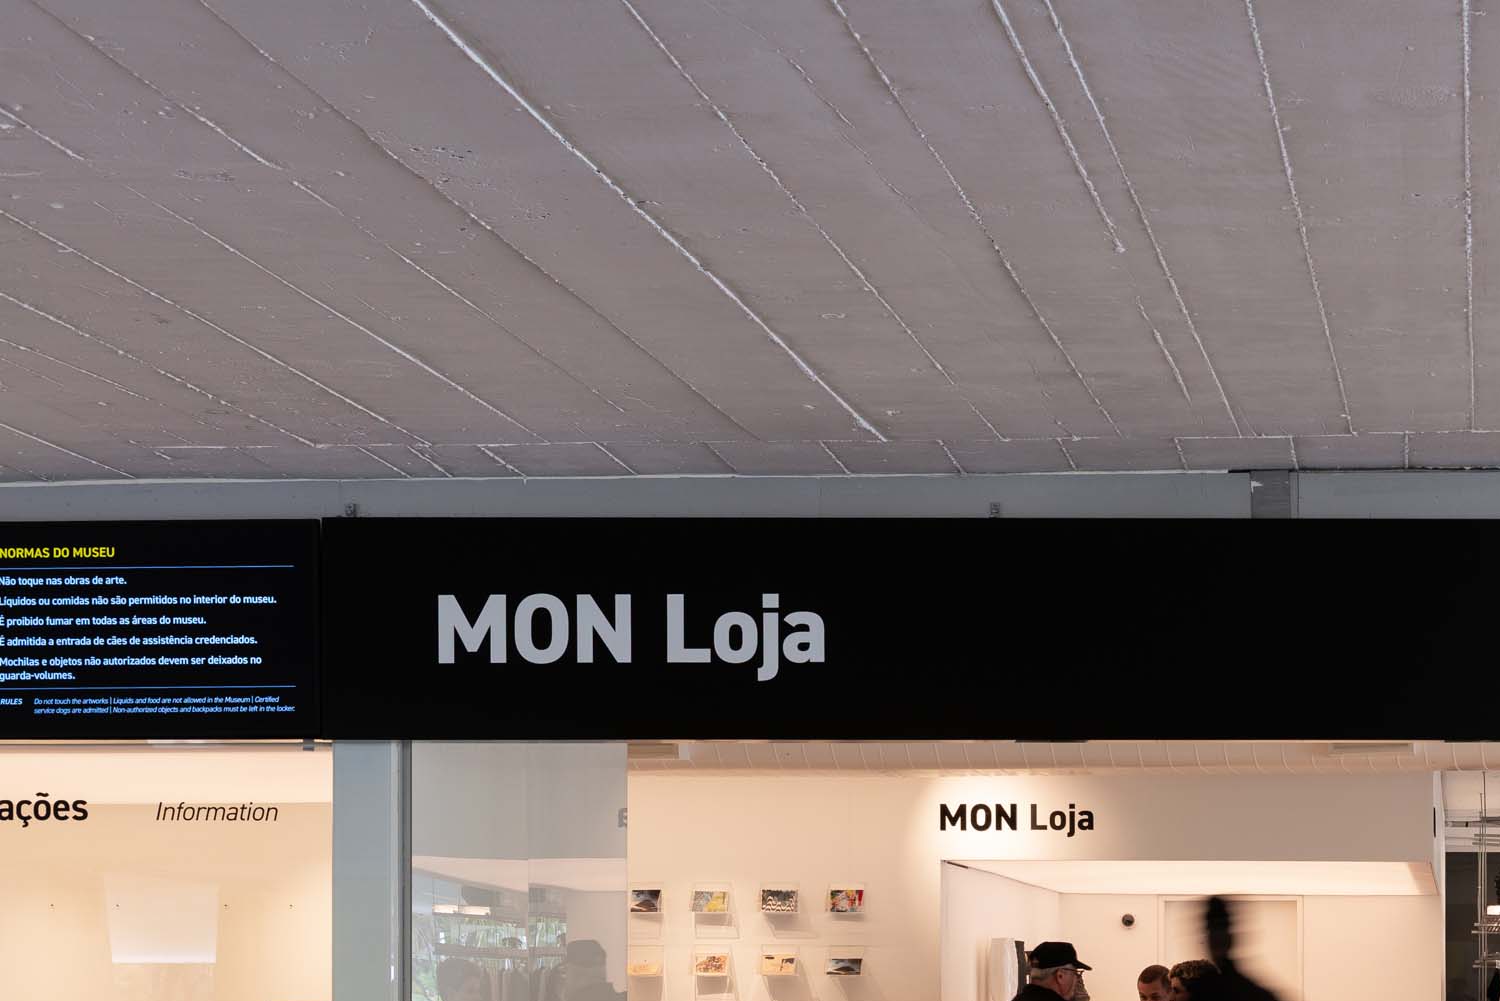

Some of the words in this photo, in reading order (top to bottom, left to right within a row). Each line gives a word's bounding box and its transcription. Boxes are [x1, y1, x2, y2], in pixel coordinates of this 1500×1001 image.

[0, 548, 49, 558] NORMAS
[53, 548, 69, 558] DO
[73, 547, 115, 557] MUSEU
[0, 577, 16, 586] Não
[18, 577, 43, 587] toque
[46, 577, 62, 585] nas
[64, 576, 90, 585] obras
[92, 576, 103, 585] de
[105, 576, 127, 585] arte.
[0, 596, 36, 607] Líquidos
[38, 597, 49, 606] ou
[52, 596, 89, 606] comidas
[92, 596, 108, 605] não
[111, 596, 126, 605] são
[129, 595, 177, 606] permitidos
[180, 596, 191, 604] no
[193, 595, 227, 604] interior
[229, 595, 241, 604] do
[243, 595, 277, 604] museu.
[0, 615, 5, 626] É
[7, 616, 44, 628] proibido
[46, 616, 73, 626] fumar
[76, 617, 90, 625] em
[92, 616, 117, 625] todas
[120, 617, 130, 625] as
[132, 615, 157, 625] áreas
[159, 615, 171, 624] do
[173, 616, 206, 624] museu.
[0, 635, 5, 646] É
[7, 636, 46, 646] admitida
[48, 638, 54, 646] a
[56, 636, 91, 645] entrada
[93, 636, 104, 645] de
[107, 636, 127, 645] cães
[130, 636, 140, 645] de
[143, 635, 193, 645] assistência
[195, 635, 258, 644] credenciados.
[438, 593, 632, 664] MON
[666, 593, 826, 682] Loja
[0, 657, 39, 666] Mochilas
[50, 657, 82, 668] objetos
[84, 656, 101, 666] não
[103, 656, 156, 665] autorizados
[158, 656, 189, 665] devem
[191, 657, 206, 665] ser
[208, 655, 248, 664] deixados
[250, 656, 262, 664] no
[0, 671, 75, 682] guarda-volumes.
[0, 792, 88, 827] ações
[156, 802, 279, 821] Information
[940, 804, 1017, 831] MON
[1030, 804, 1094, 837] Loja
